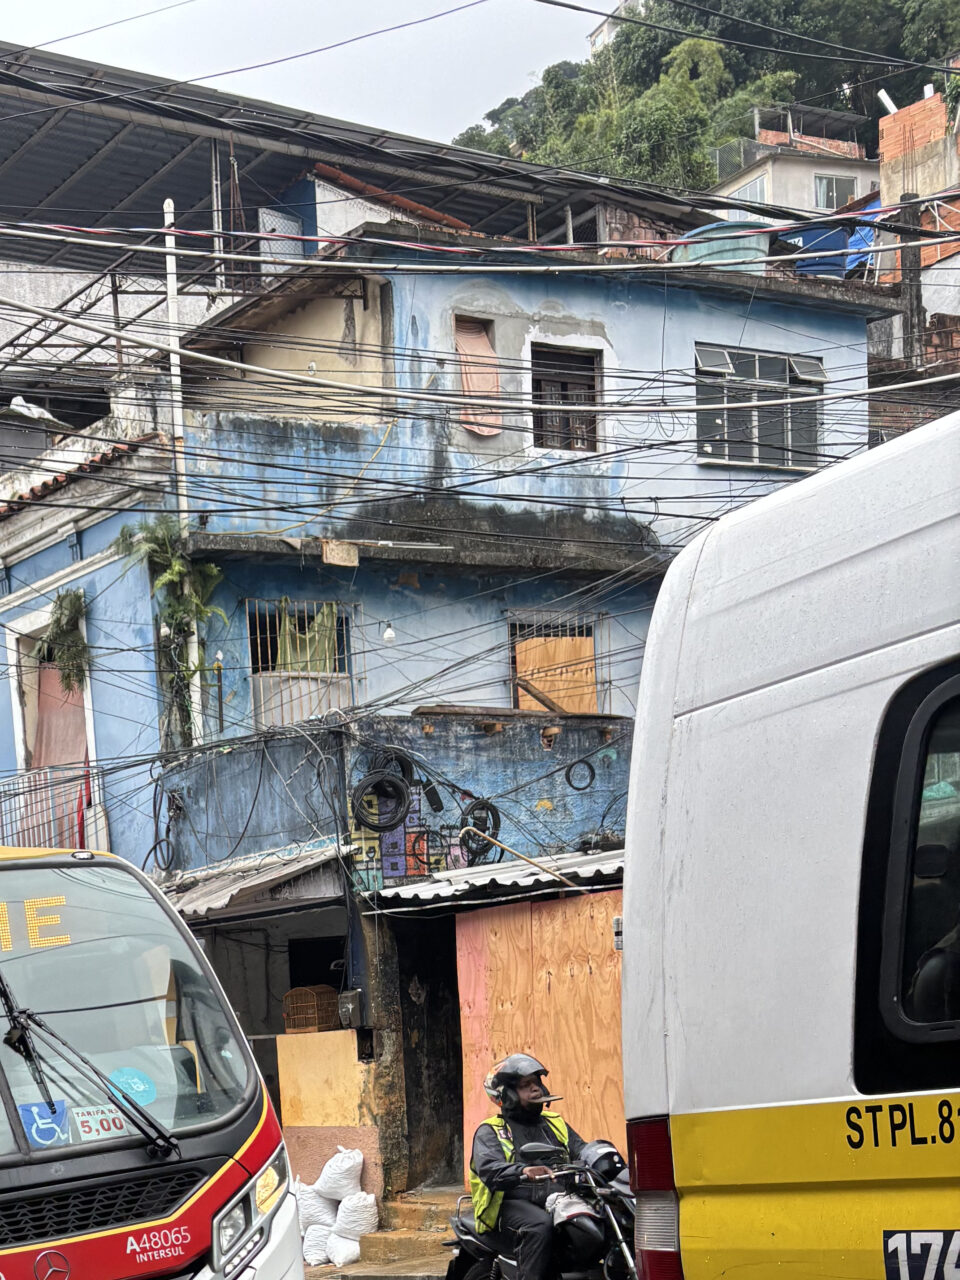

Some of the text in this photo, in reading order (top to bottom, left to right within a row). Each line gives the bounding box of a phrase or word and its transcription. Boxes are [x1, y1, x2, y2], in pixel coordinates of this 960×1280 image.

[75, 1110, 105, 1118] TARIFA
[80, 1116, 124, 1136] 5,00
[126, 1225, 191, 1254] A48065
[136, 1246, 185, 1263] INTERSUL
